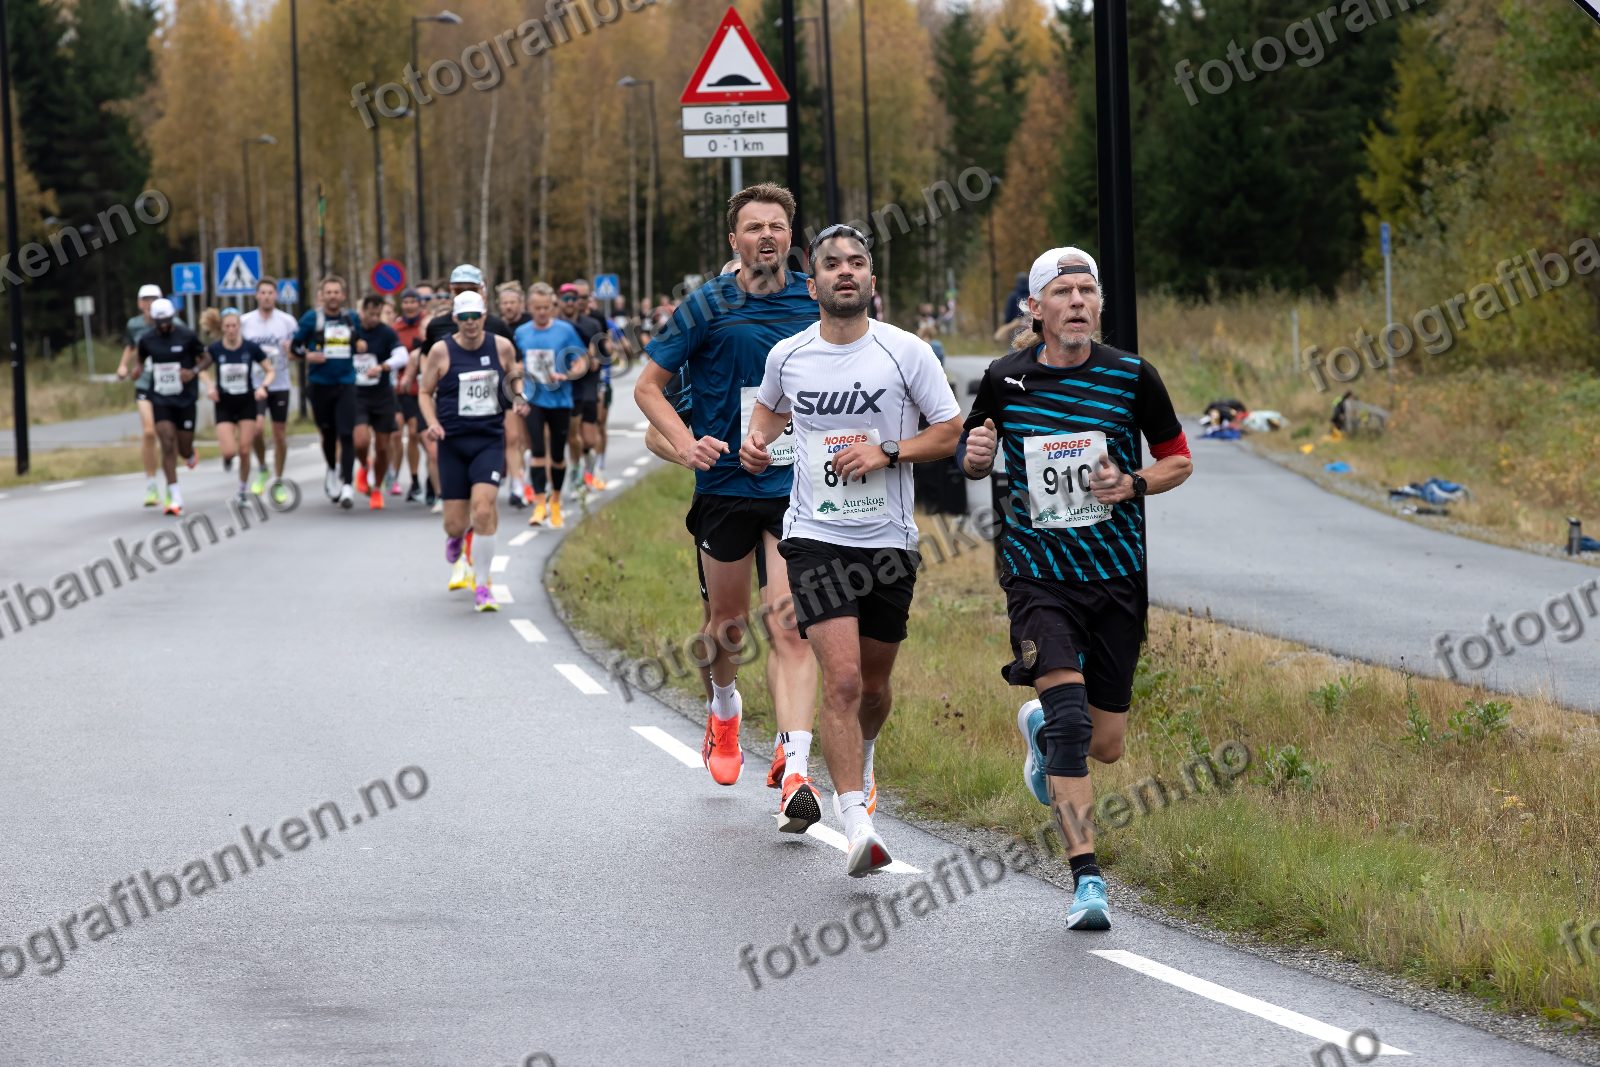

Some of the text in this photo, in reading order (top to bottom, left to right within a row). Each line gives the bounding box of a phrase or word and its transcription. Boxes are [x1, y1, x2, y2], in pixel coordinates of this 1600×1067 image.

[703, 110, 767, 127] Gangfelt
[708, 139, 718, 152] 0
[733, 139, 738, 151] 1
[743, 138, 764, 151] km
[466, 385, 490, 399] 408
[823, 434, 868, 446] NORGES
[1041, 438, 1092, 452] NORGES
[770, 445, 795, 456] Aursk
[1047, 448, 1085, 460] LØPET
[1042, 463, 1093, 495] 910
[842, 496, 885, 508] Aurskog
[1065, 503, 1110, 517] Aurskog
